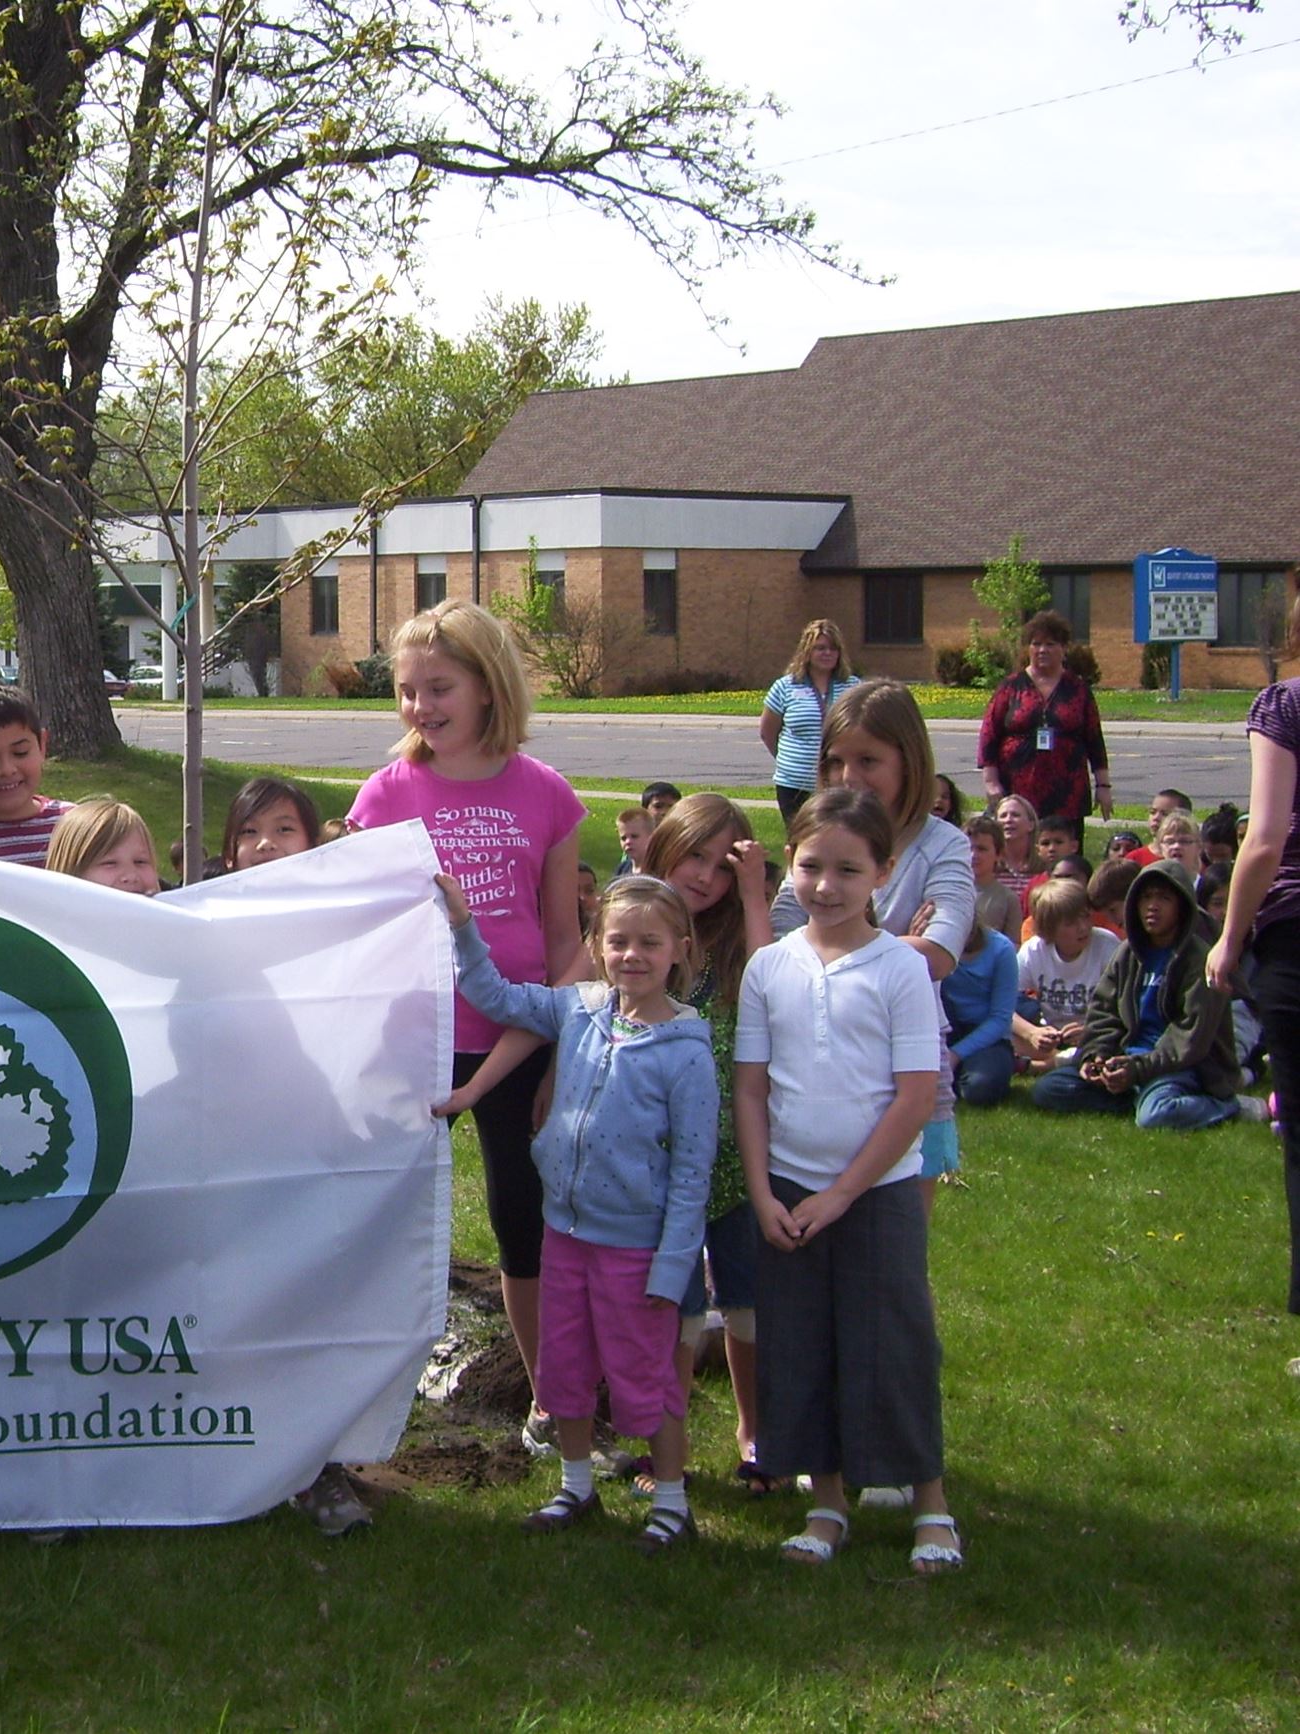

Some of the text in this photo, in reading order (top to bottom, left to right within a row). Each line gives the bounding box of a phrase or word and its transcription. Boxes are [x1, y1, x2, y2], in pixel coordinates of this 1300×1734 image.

[435, 805, 517, 825] So many
[453, 823, 499, 836] social
[432, 836, 531, 850] ngagements
[458, 866, 504, 891] little
